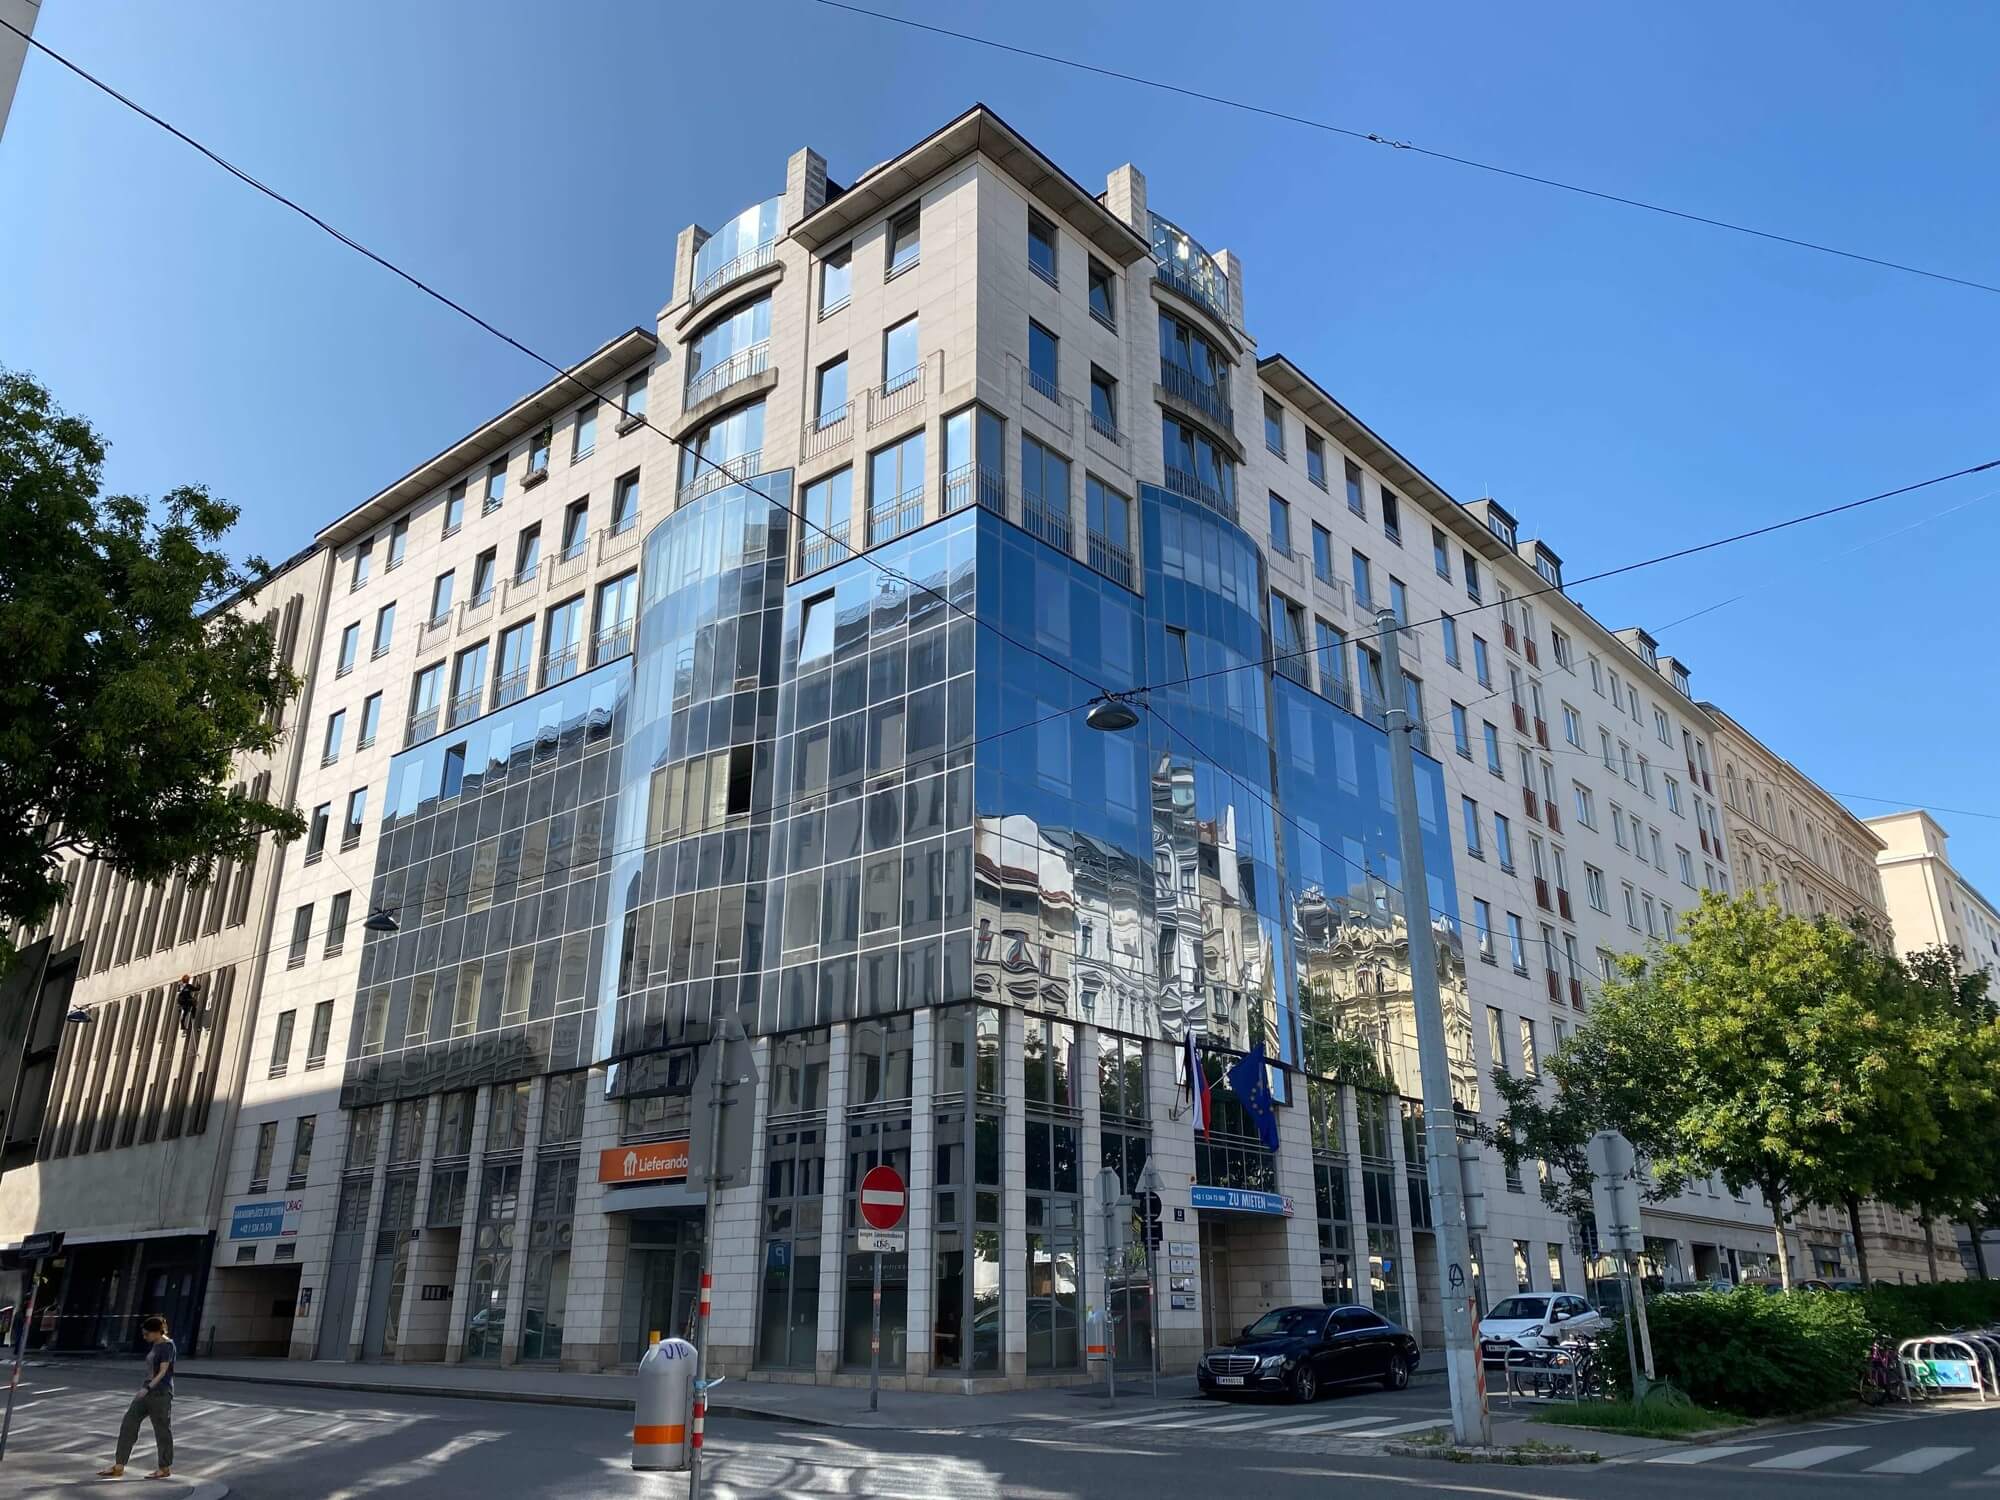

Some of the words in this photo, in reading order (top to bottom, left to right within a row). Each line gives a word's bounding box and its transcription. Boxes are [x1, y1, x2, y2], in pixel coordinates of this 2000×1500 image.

[639, 1153, 689, 1172] Lieferando
[1228, 1192, 1239, 1206] ZU
[1241, 1194, 1266, 1209] MIETEN
